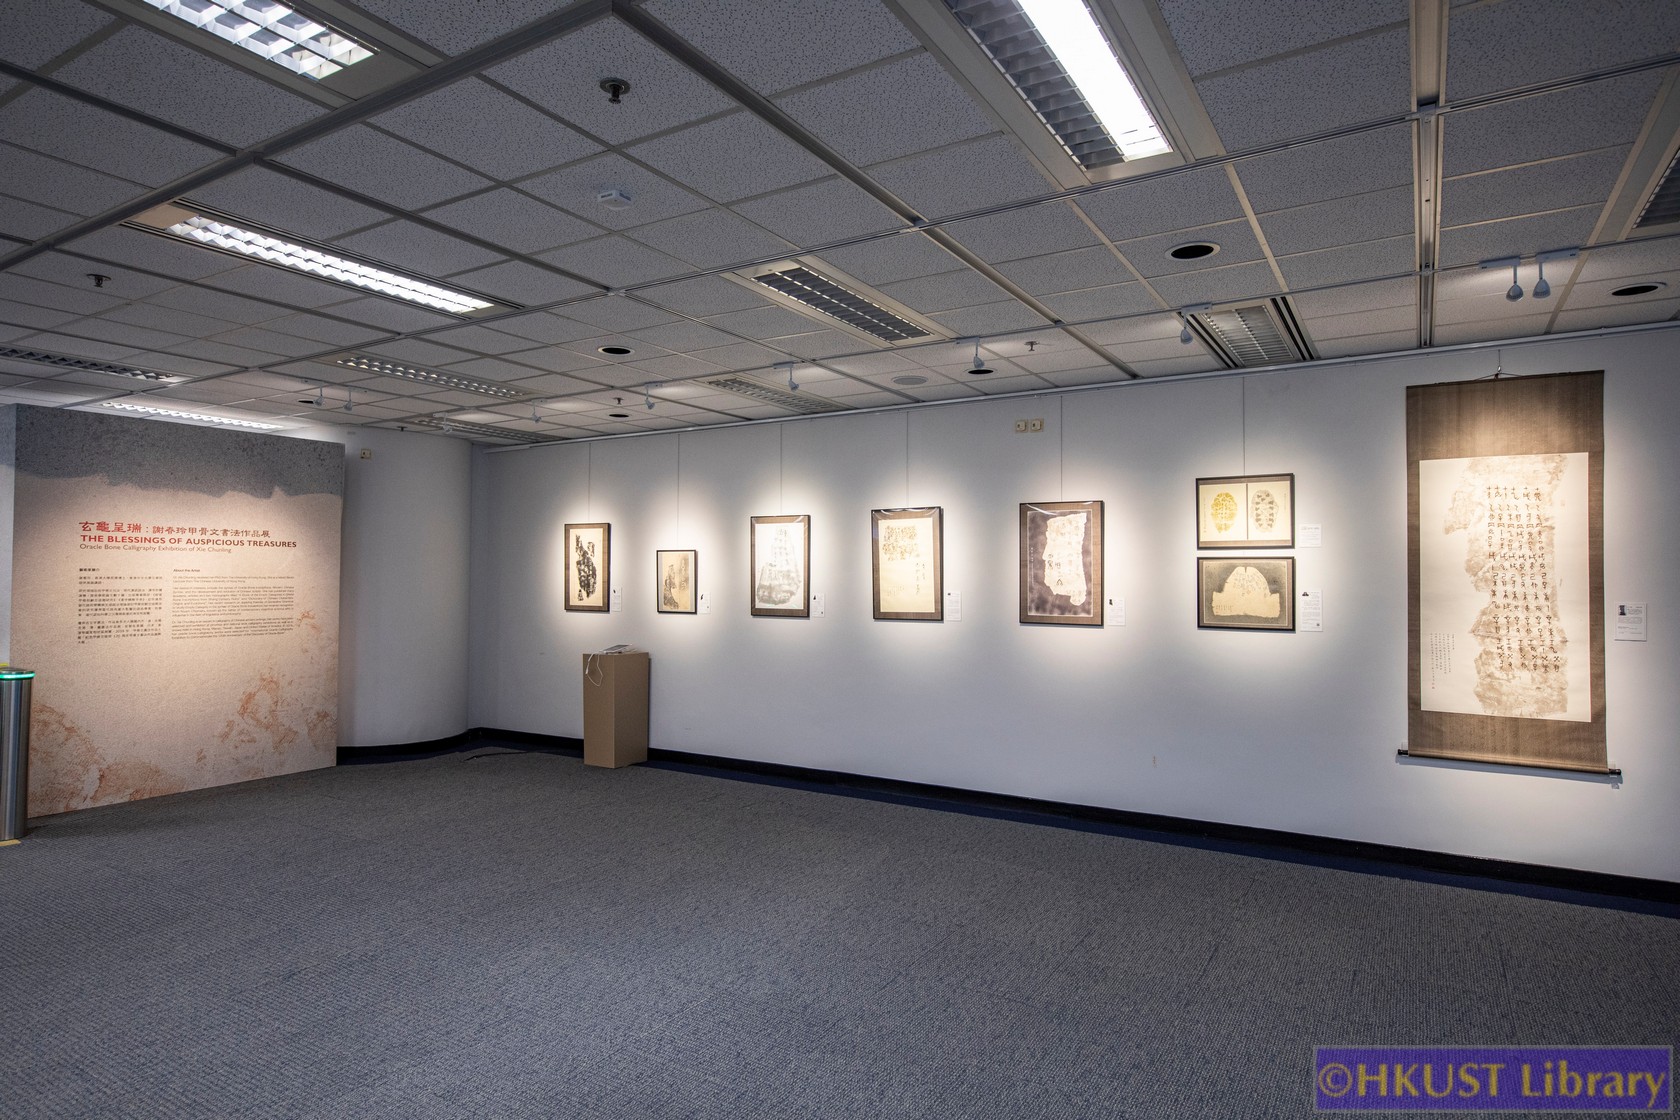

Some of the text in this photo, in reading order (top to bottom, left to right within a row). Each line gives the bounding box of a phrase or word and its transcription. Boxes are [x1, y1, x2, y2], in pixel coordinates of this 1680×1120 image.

[80, 535, 297, 548] THE BLESSINGS OF AUSPICIOUS TREASURES
[123, 544, 156, 552] Calligraphy
